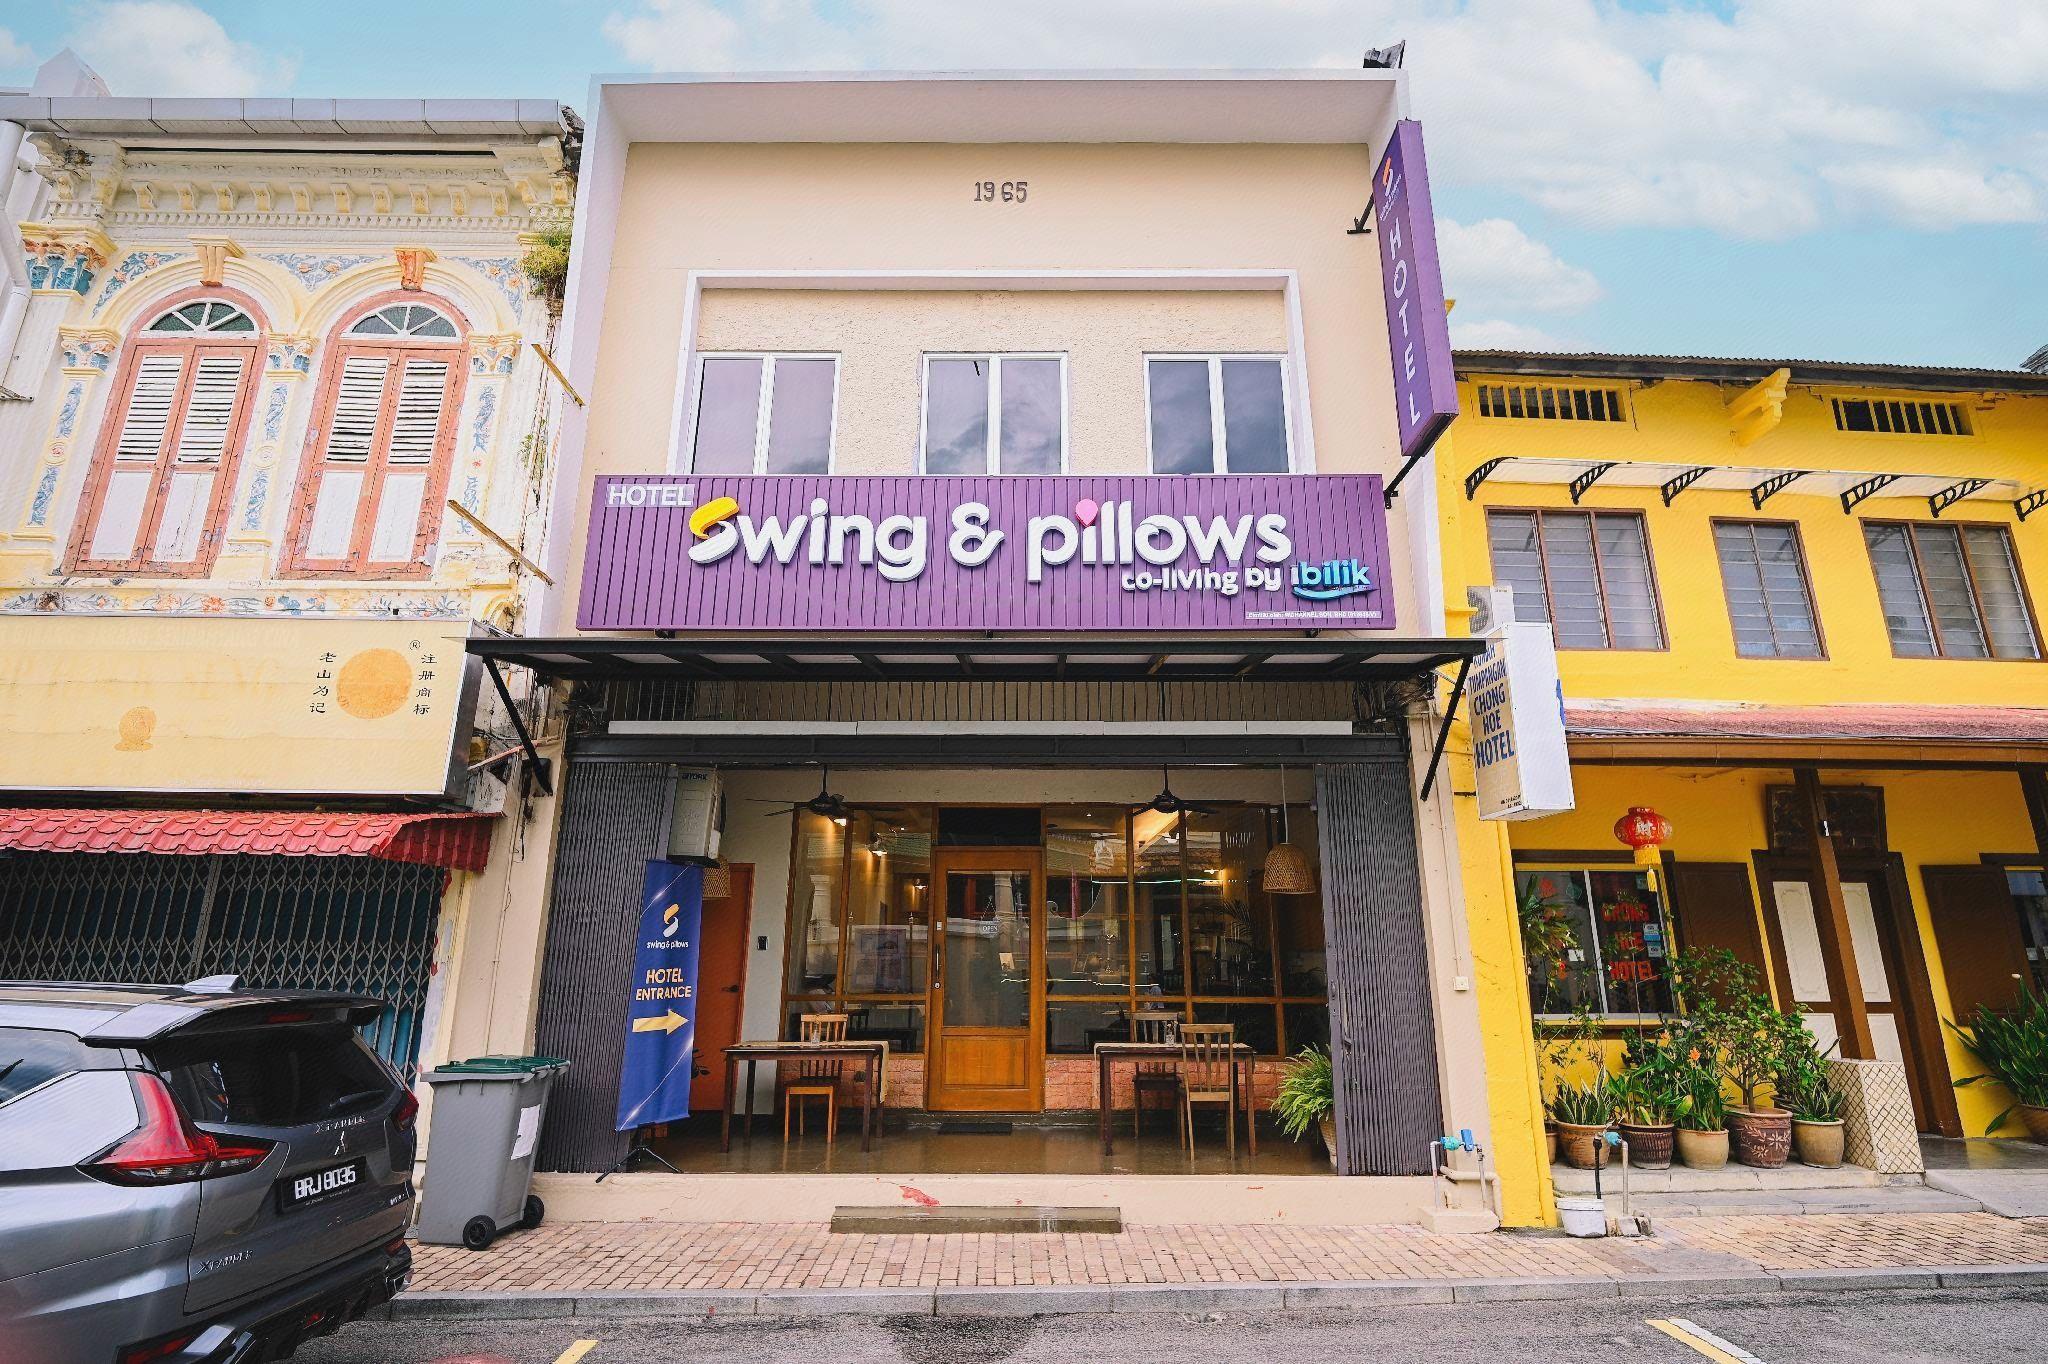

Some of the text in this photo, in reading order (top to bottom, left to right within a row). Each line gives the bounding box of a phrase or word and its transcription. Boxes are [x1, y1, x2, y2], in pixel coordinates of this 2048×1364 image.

[974, 181, 1028, 203] 1965
[1389, 216, 1421, 426] HOTEL
[608, 485, 695, 506] HOTEL
[949, 501, 1006, 567] &
[1027, 498, 1292, 584] pillows
[1121, 558, 1371, 596] co-living by ibilik
[412, 653, 438, 715] 注册商标
[1468, 657, 1508, 695] TUMPANGAN
[1473, 682, 1506, 716] CHONG
[1482, 707, 1502, 737] HOE
[1475, 730, 1515, 769] HOTEL
[646, 940, 666, 949] swing
[670, 940, 689, 949] pillows
[635, 985, 692, 1001] ENTRANCE
[645, 967, 684, 984] HOTEL
[294, 1173, 322, 1200] BRJ
[323, 1164, 356, 1191] 8035
